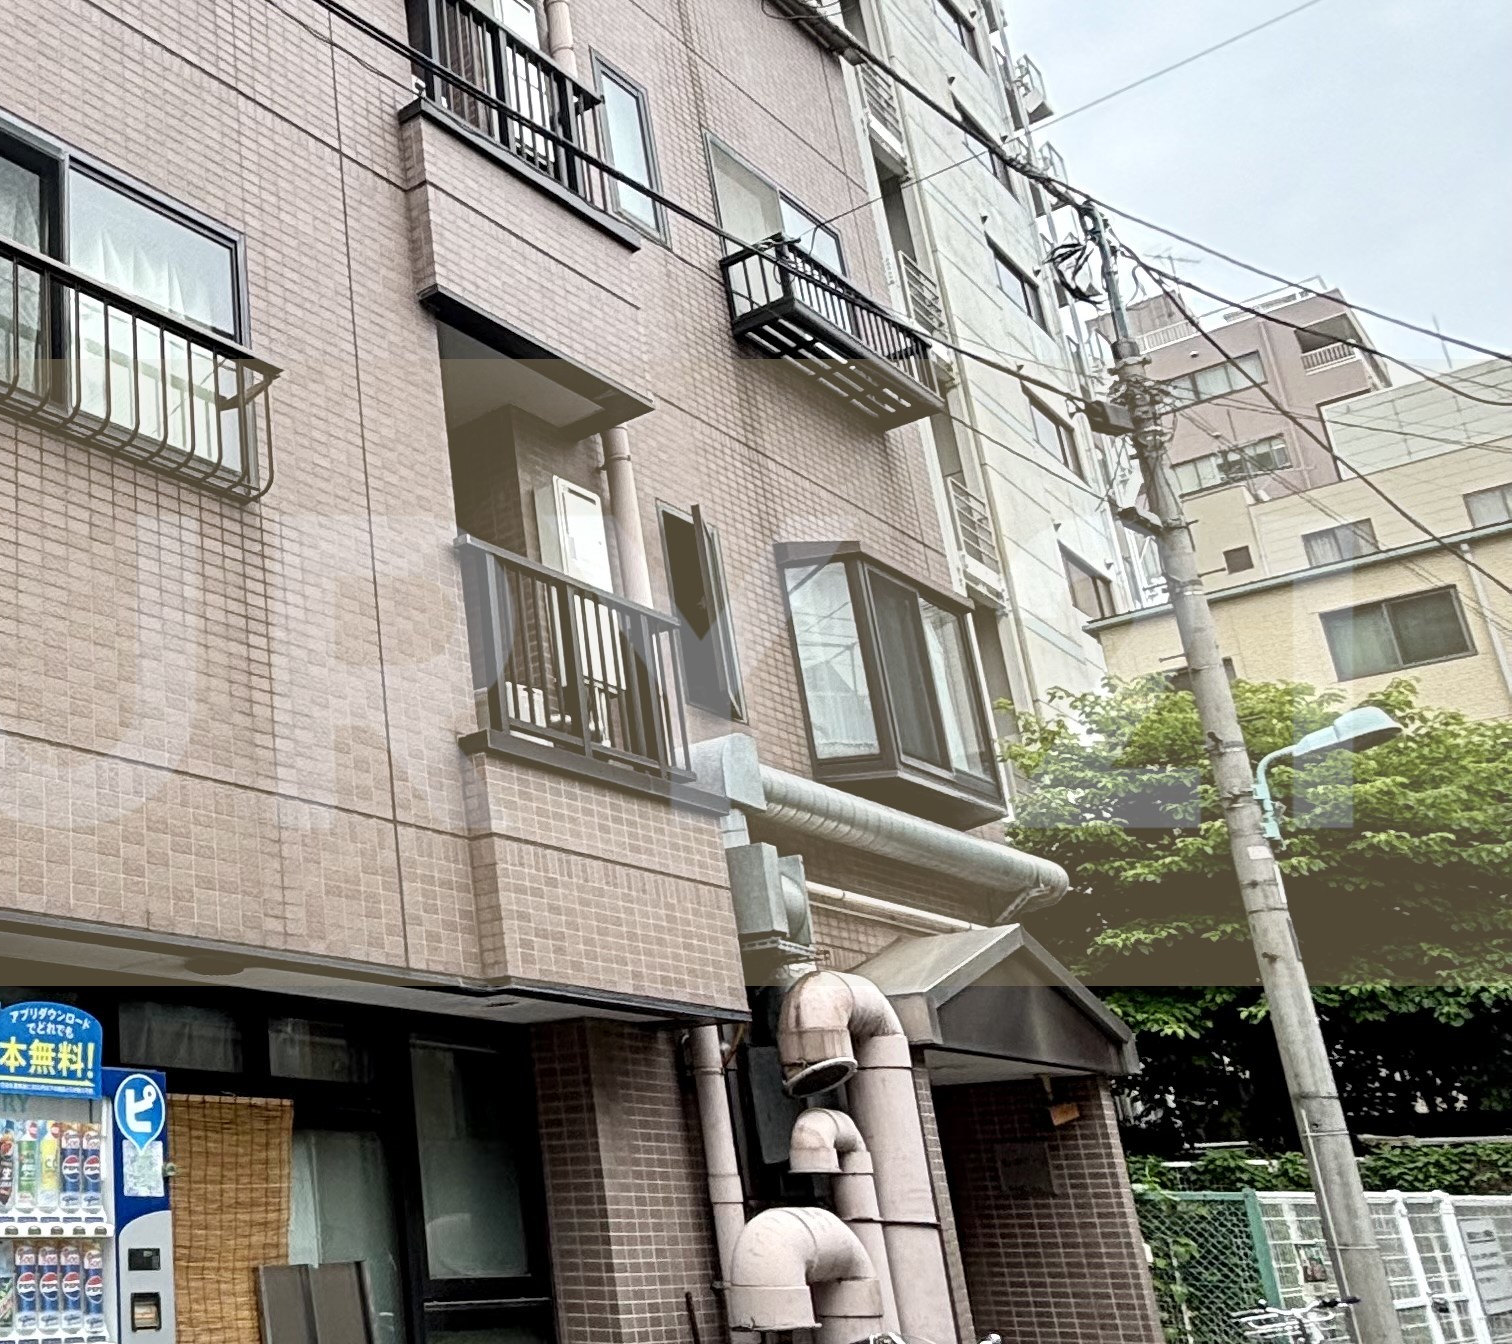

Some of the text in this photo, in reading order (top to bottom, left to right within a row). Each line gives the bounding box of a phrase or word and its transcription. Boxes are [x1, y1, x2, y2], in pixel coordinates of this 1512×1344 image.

[9, 1007, 92, 1030] アプリダウンロード
[26, 1022, 75, 1039] でどれでも
